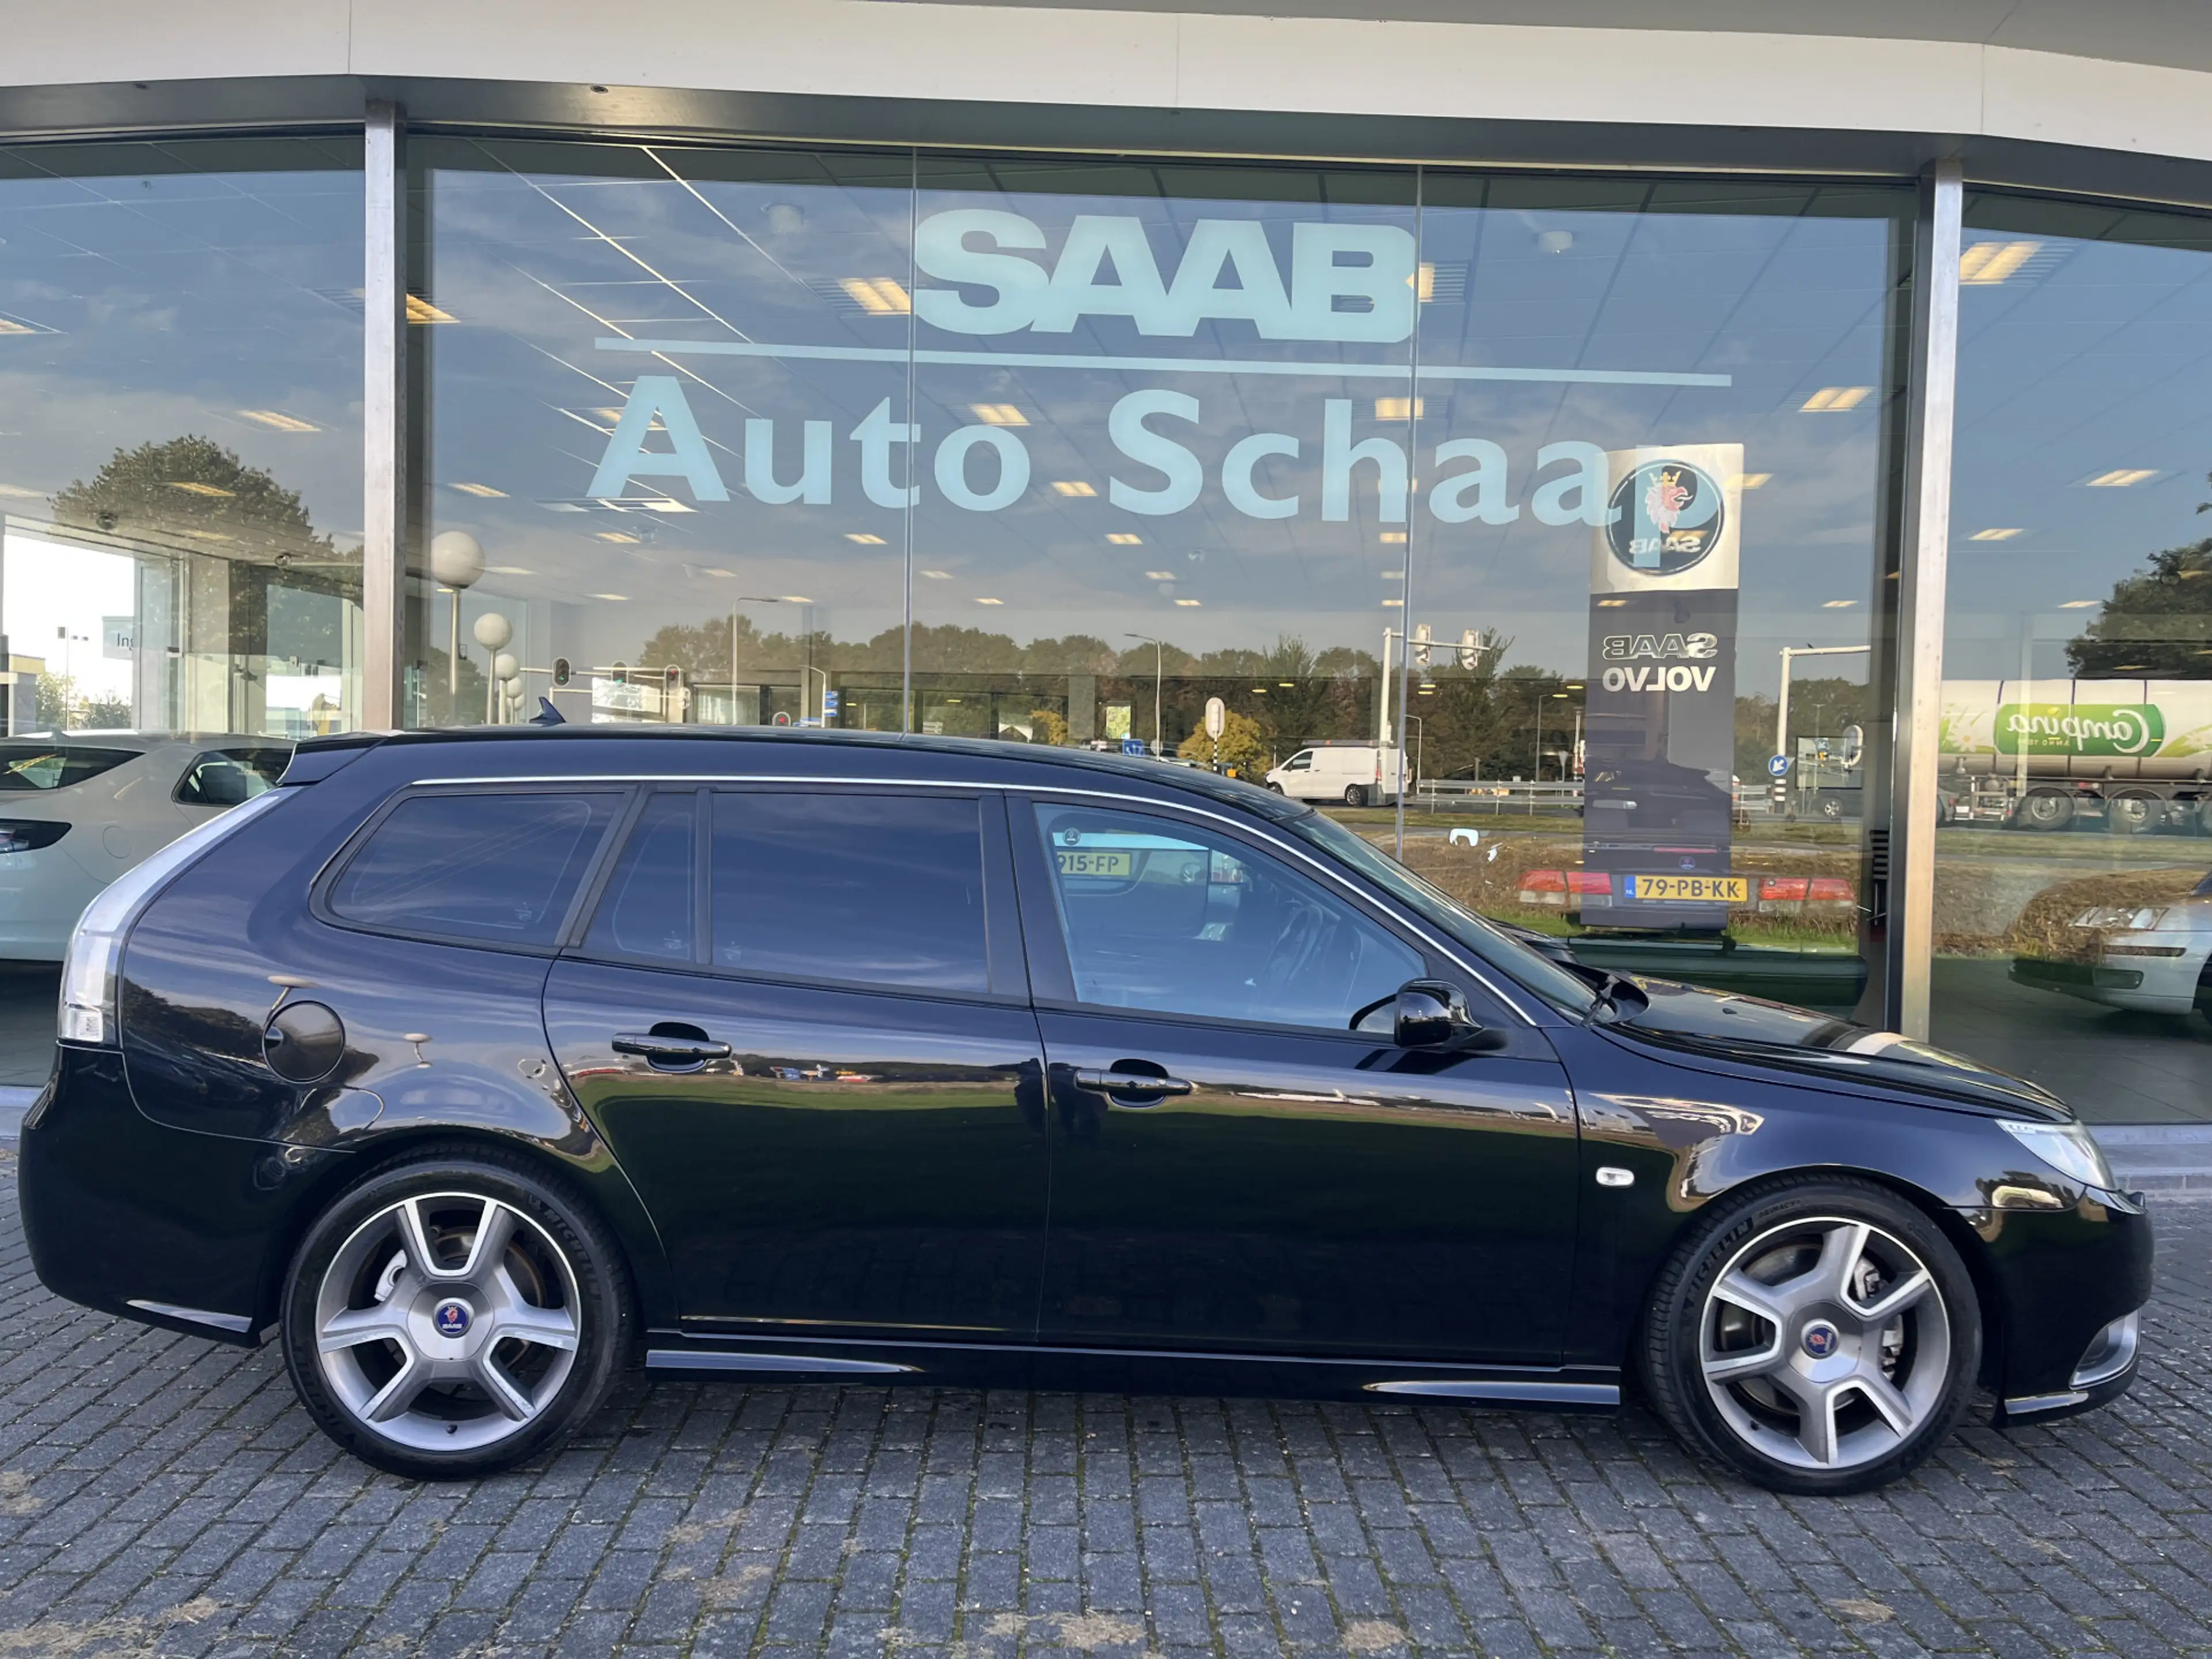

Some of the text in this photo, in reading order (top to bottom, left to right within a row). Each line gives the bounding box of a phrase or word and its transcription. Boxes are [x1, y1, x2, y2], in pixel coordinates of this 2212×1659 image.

[913, 208, 1421, 344] SAAB
[585, 376, 1719, 567] Auto Schaap
[1642, 878, 1740, 898] 79-PB-KK
[543, 1209, 601, 1296] MICHELIN
[1687, 1221, 1749, 1304] MICHELIN
